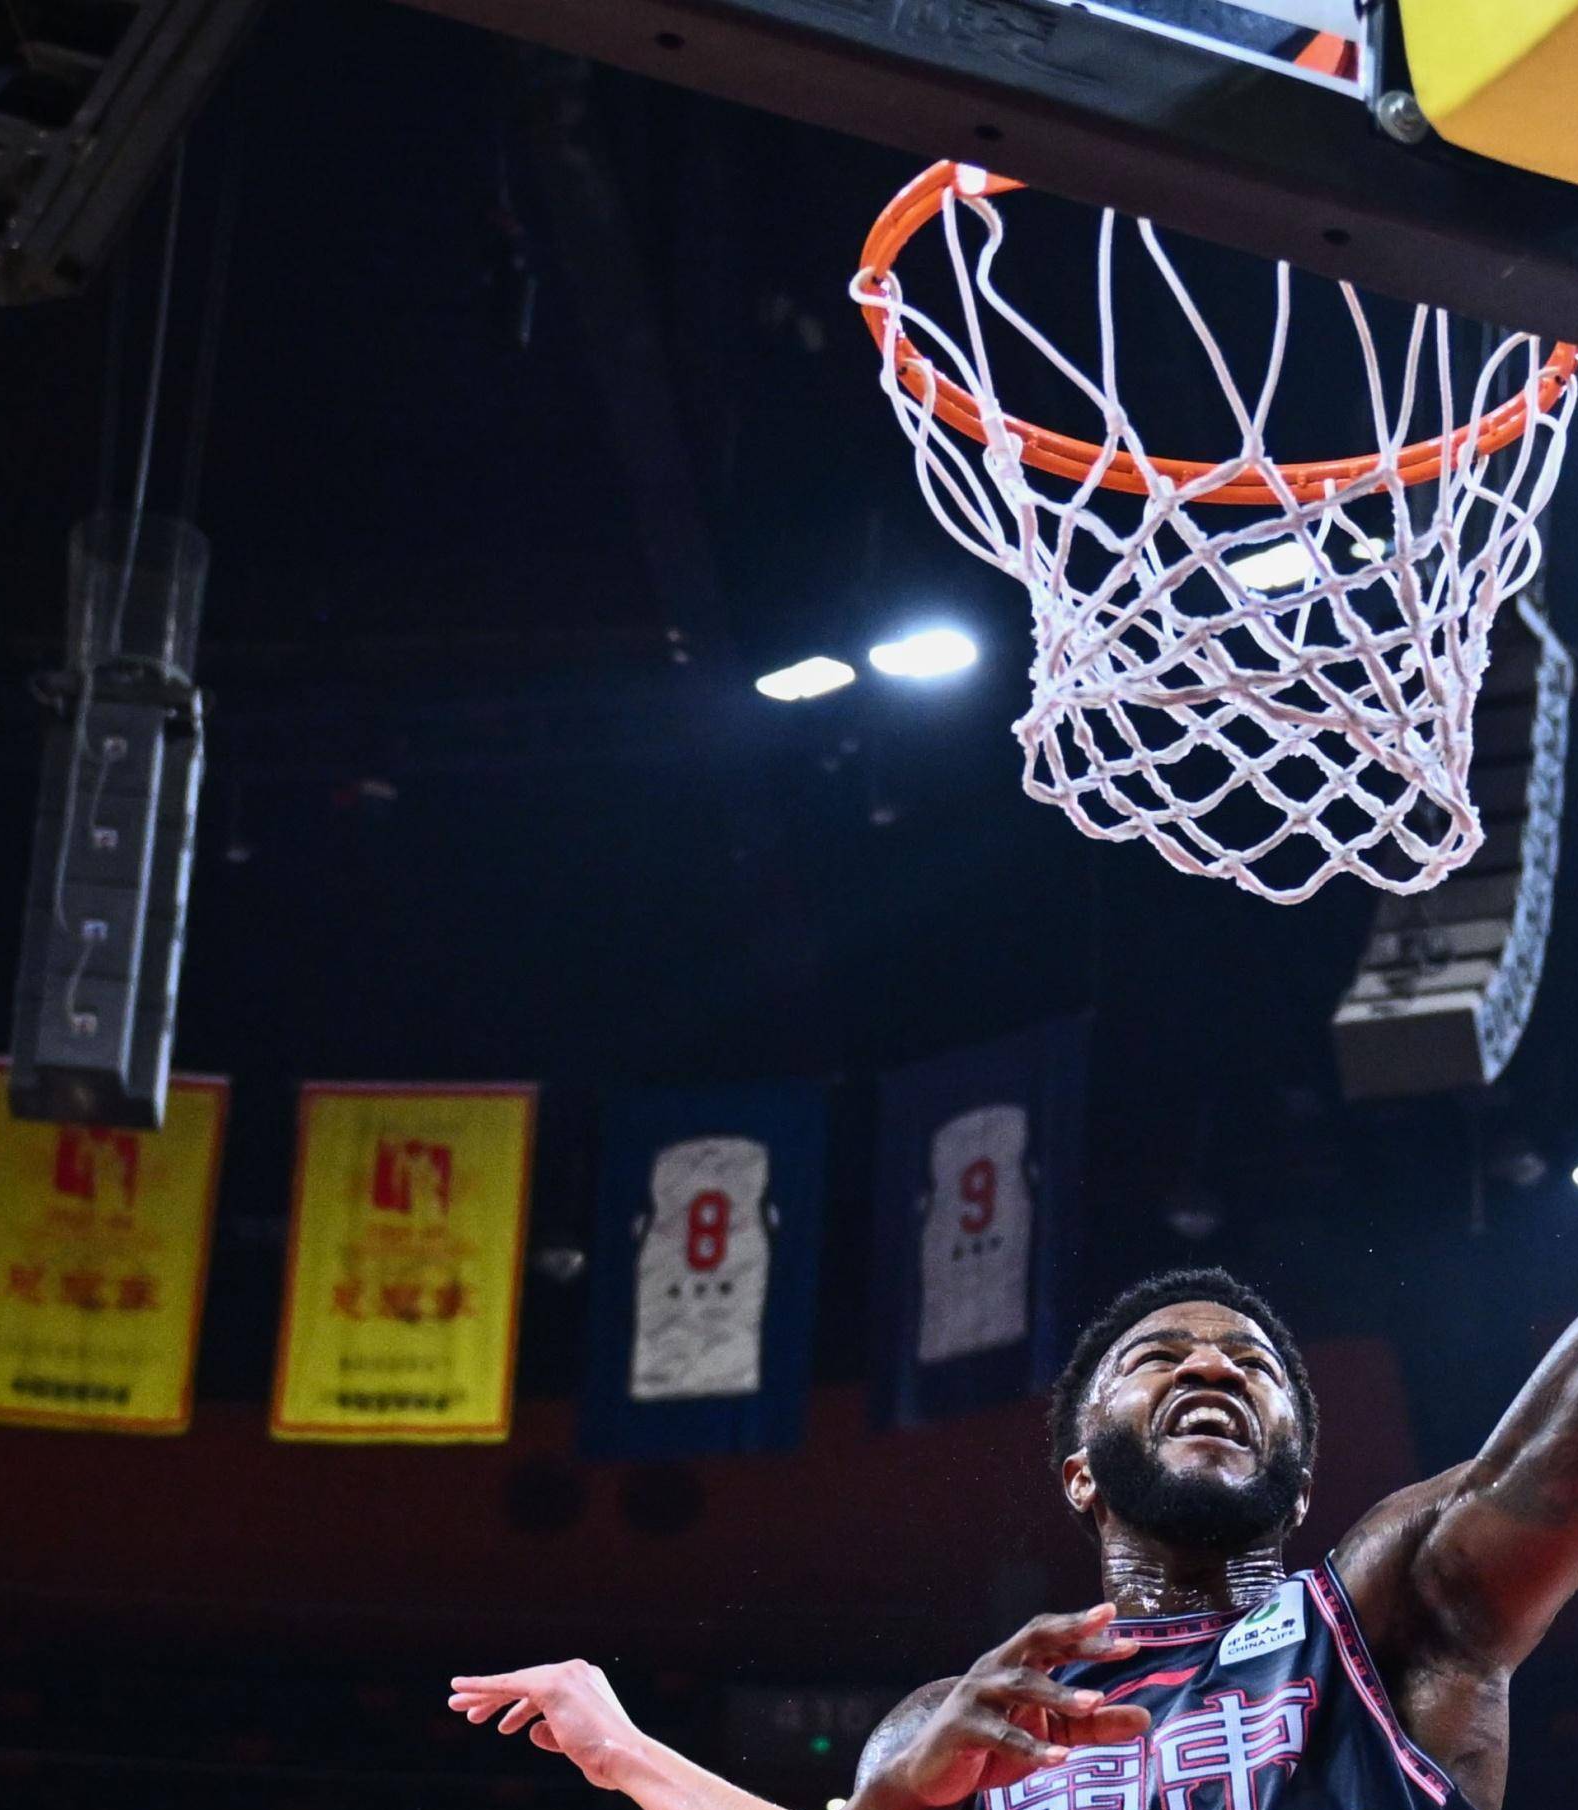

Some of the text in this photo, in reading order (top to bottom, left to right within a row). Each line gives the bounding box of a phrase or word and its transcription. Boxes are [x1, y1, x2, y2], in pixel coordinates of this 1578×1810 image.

[685, 1188, 731, 1272] 8
[959, 1156, 998, 1238] 9
[1228, 1629, 1296, 1655] CHINA LIFE
